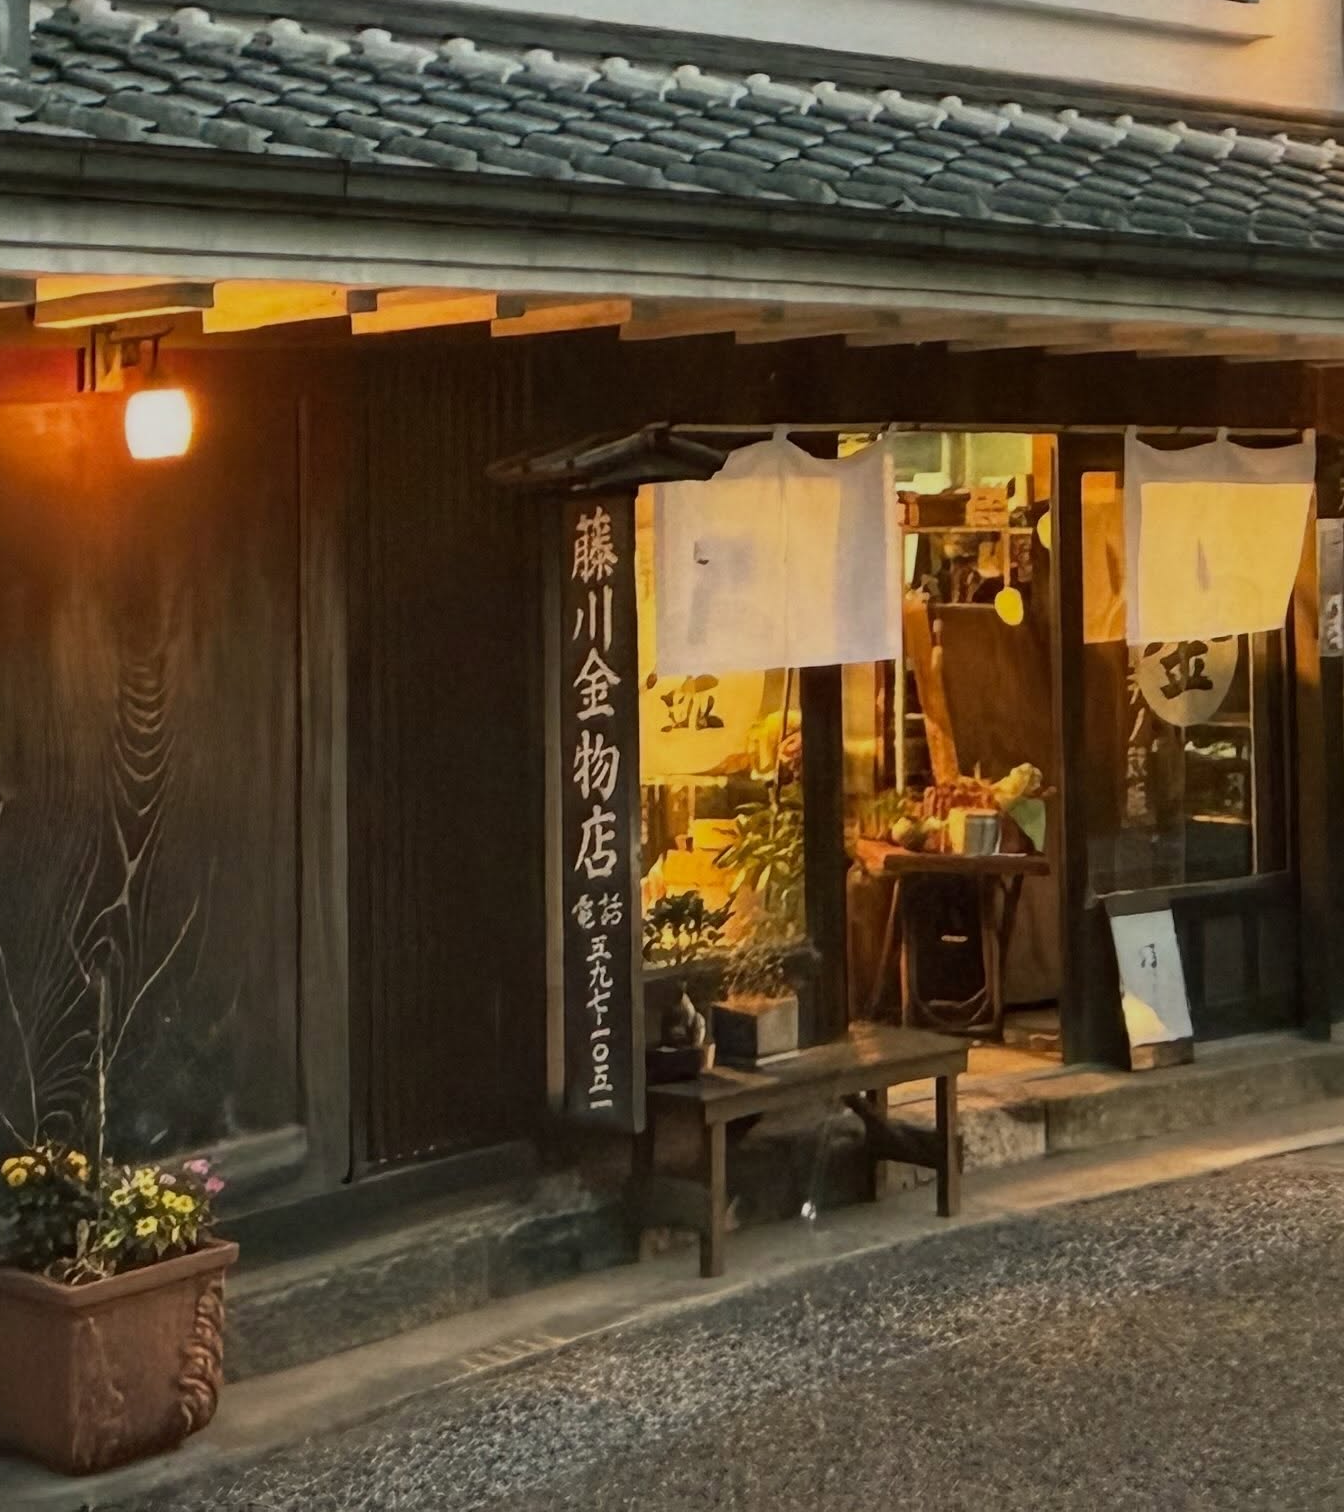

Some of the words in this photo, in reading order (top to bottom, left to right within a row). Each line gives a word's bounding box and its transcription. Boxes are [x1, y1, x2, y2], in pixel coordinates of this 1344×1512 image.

[571, 506, 622, 880] 藤川金物店
